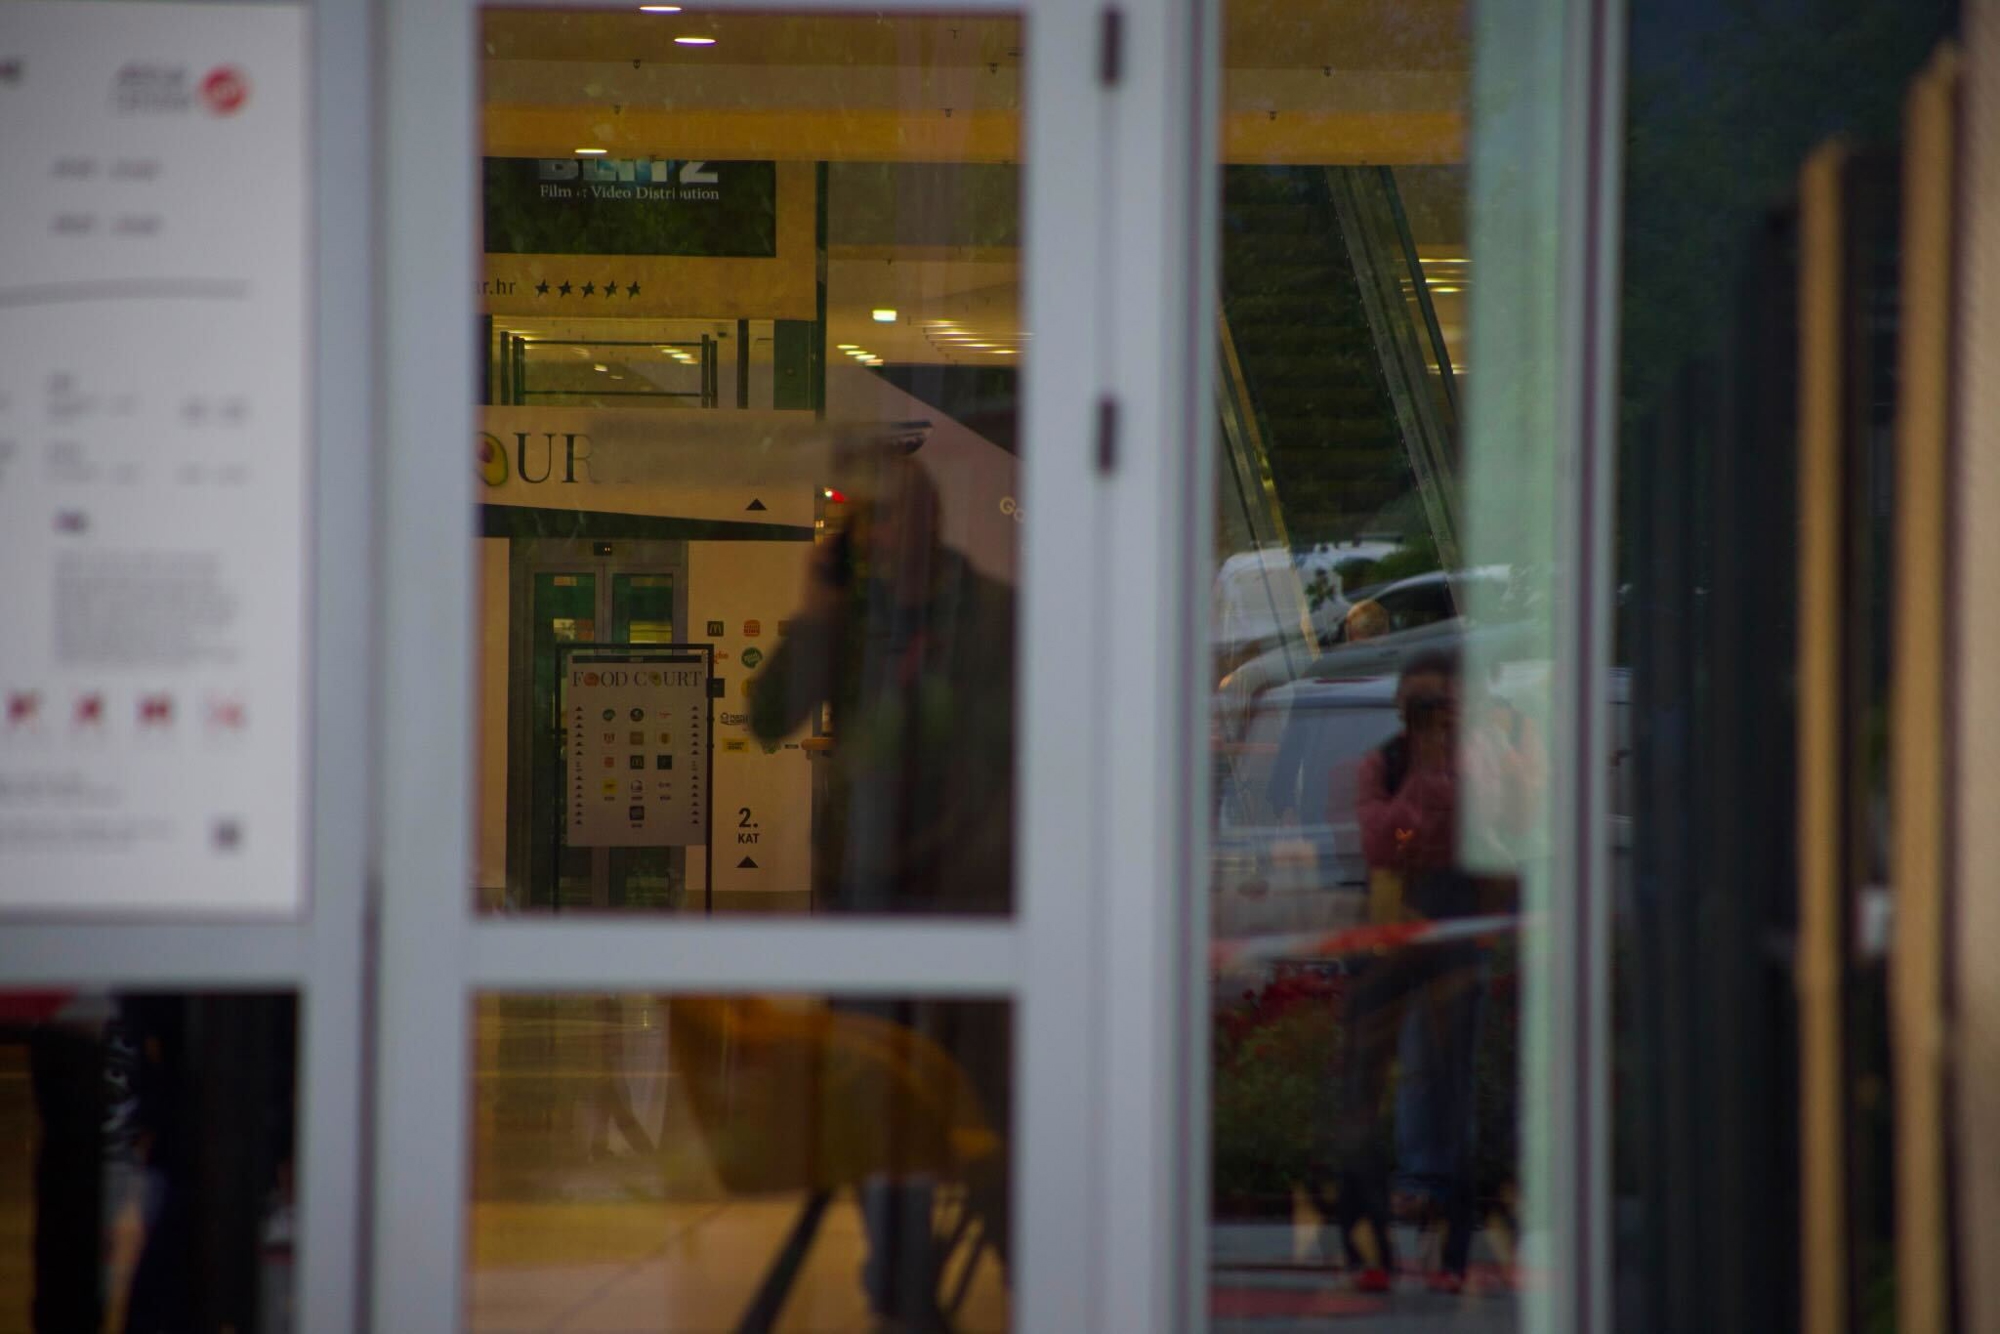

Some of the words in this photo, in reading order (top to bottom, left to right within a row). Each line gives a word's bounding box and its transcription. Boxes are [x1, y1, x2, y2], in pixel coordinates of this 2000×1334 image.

[540, 184, 572, 198] Film
[591, 186, 632, 199] Video
[572, 671, 628, 688] FOOD
[633, 671, 702, 688] COURT
[738, 807, 759, 828] 2.
[737, 832, 760, 844] KAT
